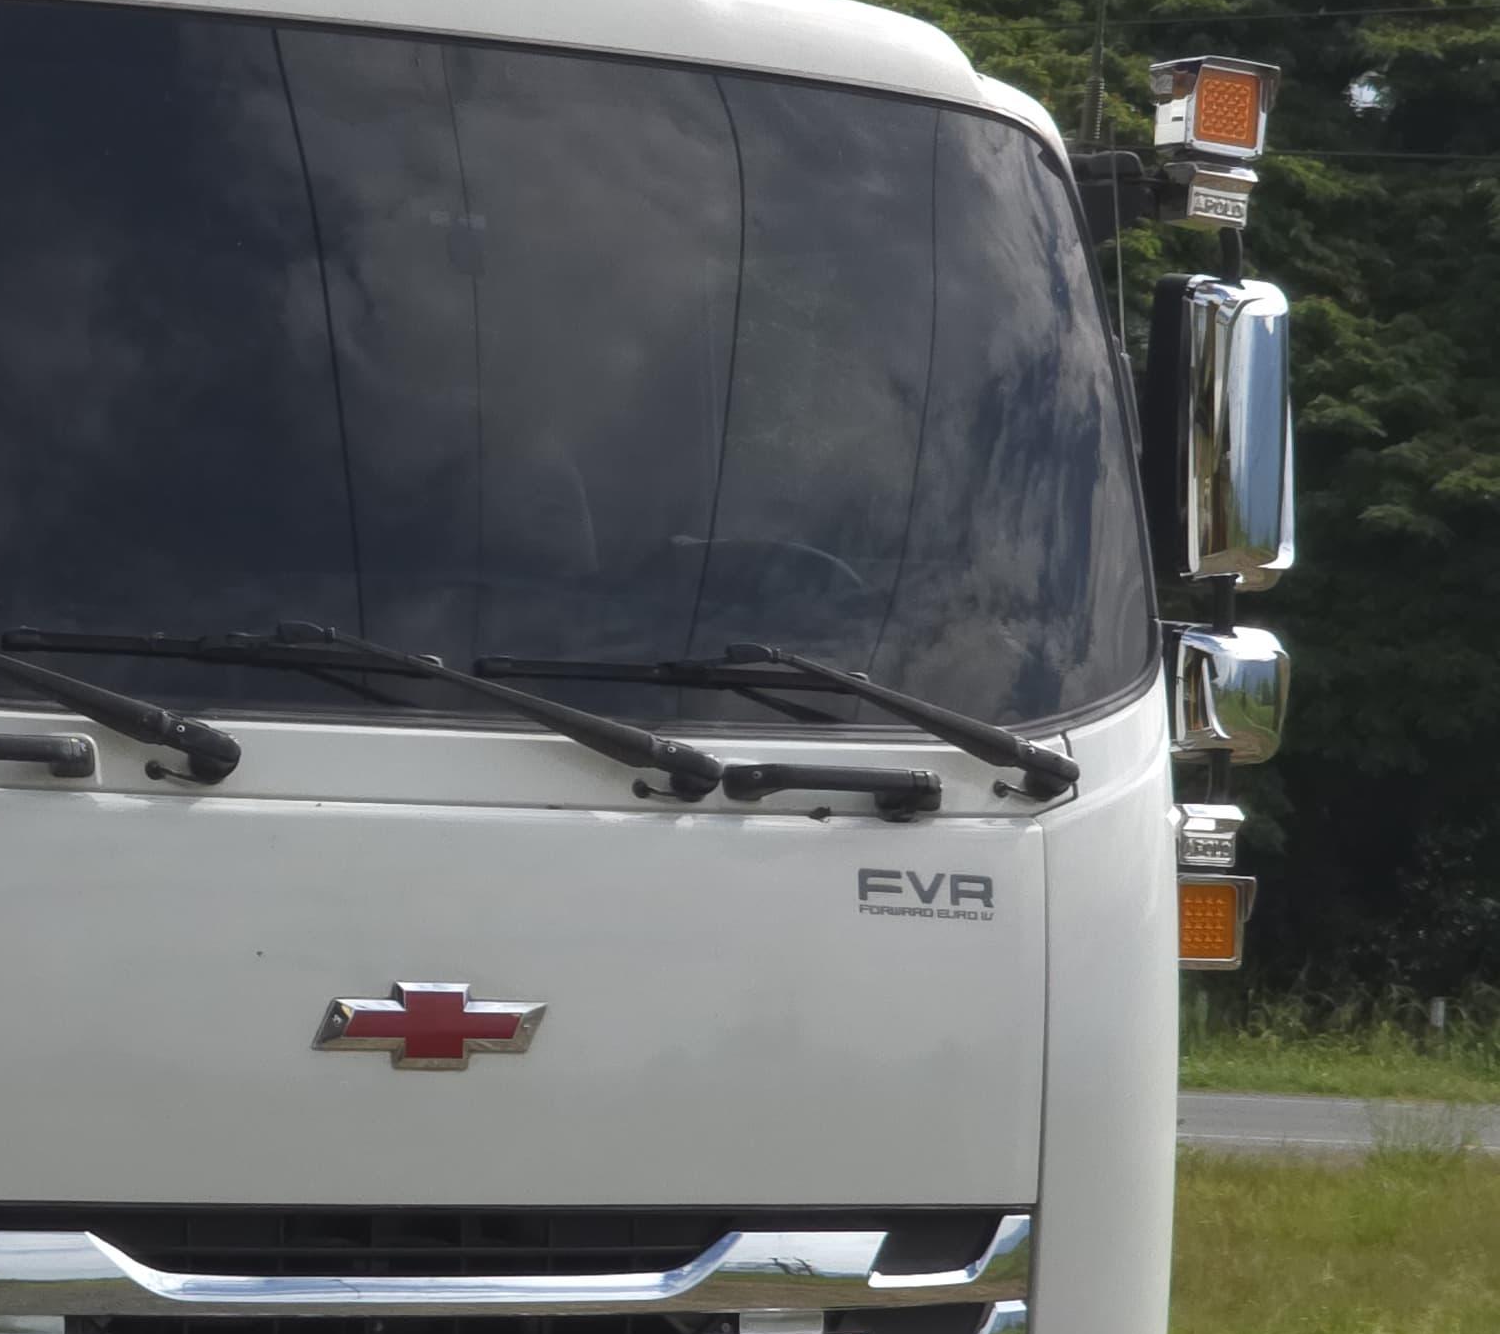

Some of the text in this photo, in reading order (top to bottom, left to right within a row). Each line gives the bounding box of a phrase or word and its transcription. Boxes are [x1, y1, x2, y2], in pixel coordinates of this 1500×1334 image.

[858, 868, 994, 908] FVR
[859, 904, 934, 918] FORWARD
[937, 908, 978, 921] EURO
